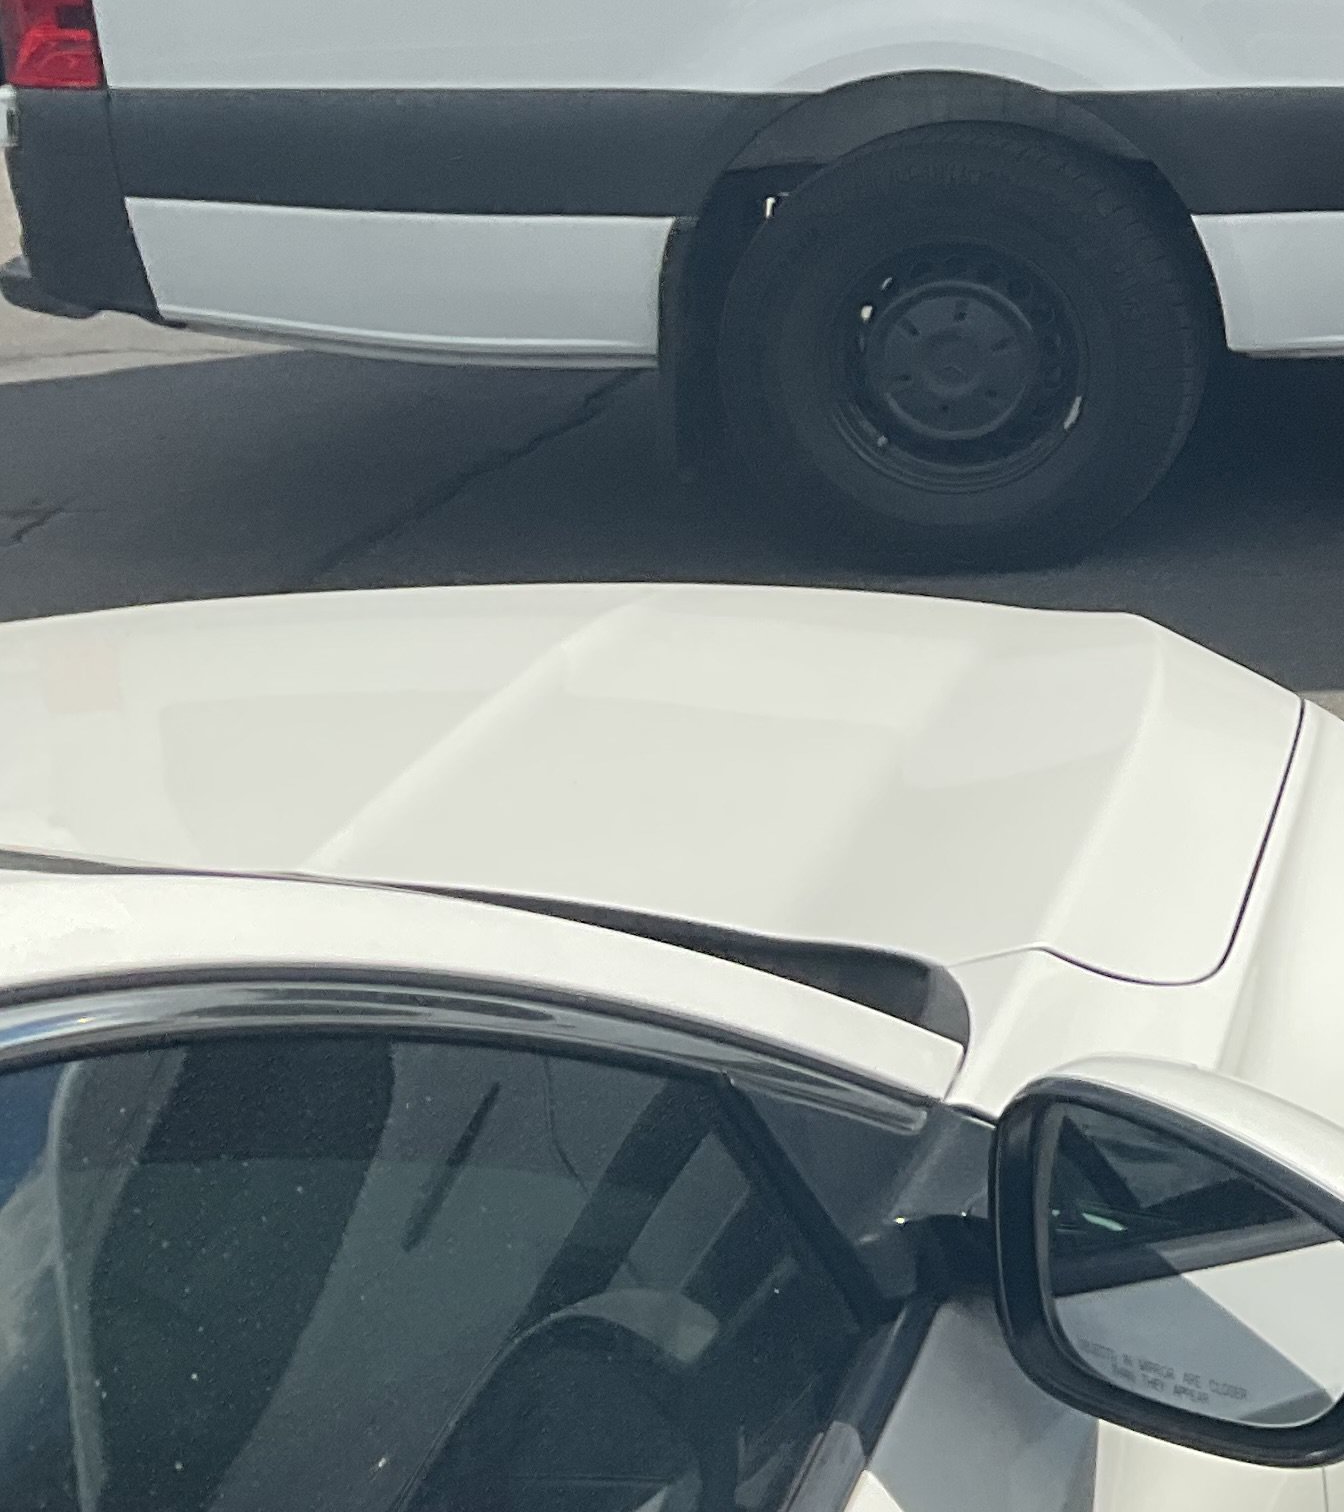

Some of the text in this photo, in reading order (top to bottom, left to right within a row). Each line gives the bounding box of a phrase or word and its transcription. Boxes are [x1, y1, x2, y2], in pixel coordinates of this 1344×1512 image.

[1138, 1359, 1175, 1380] MIRROR
[1182, 1372, 1201, 1387] ARE
[1208, 1379, 1247, 1401] CLOSER
[1172, 1384, 1209, 1404] APPEAR
